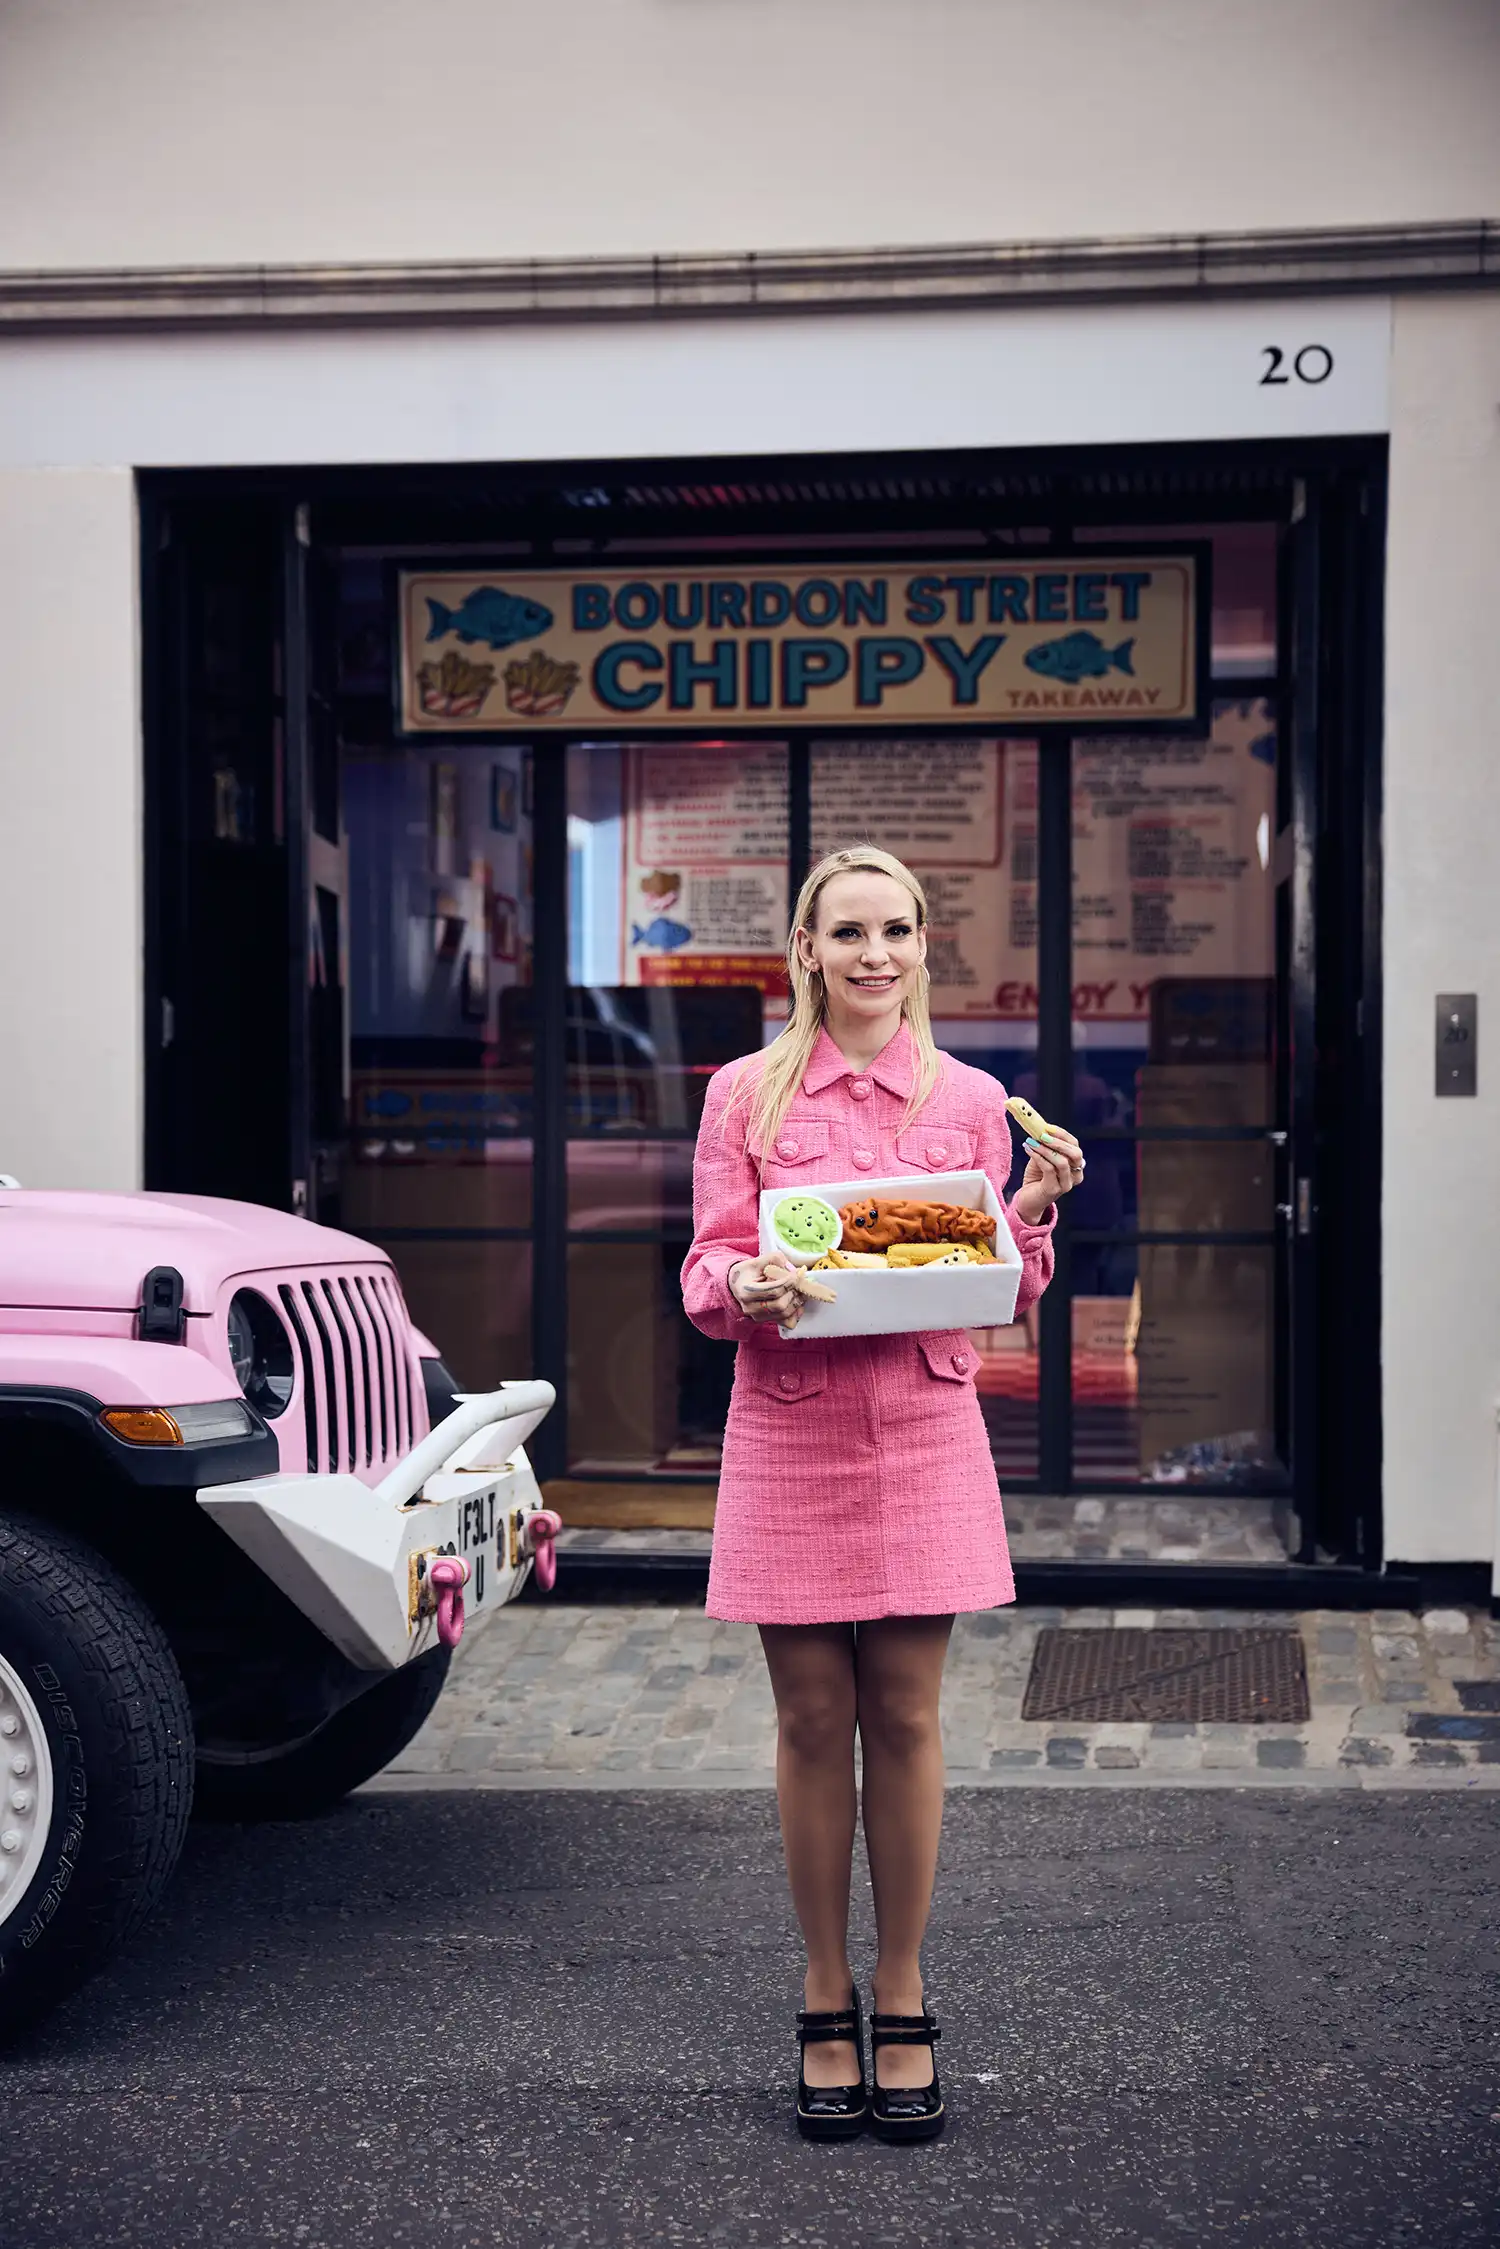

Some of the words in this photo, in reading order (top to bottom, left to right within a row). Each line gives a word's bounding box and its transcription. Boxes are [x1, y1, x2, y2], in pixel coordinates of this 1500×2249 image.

[1260, 345, 1333, 385] 20
[572, 578, 888, 632] BOURDON
[905, 573, 1152, 626] STREET
[591, 634, 1008, 713] CHIPPY
[1006, 688, 1161, 708] TAKEAWAY
[994, 980, 1118, 1012] ENOY
[19, 1663, 87, 1949] DISCOVERER
